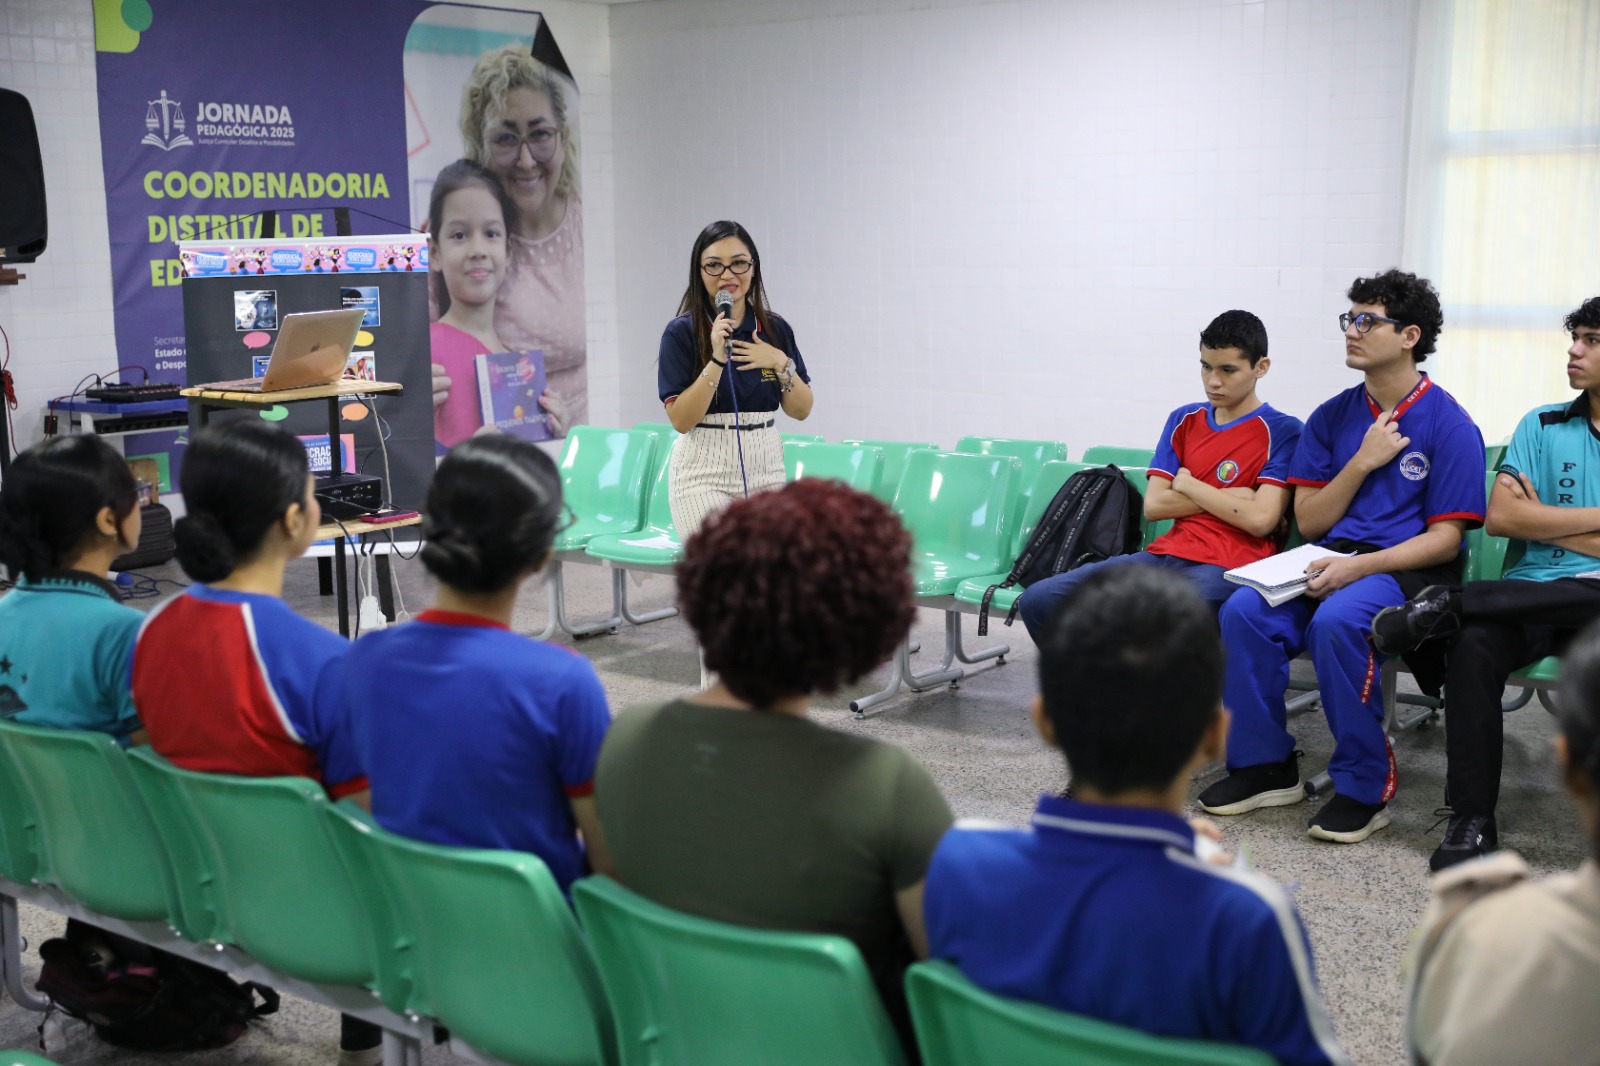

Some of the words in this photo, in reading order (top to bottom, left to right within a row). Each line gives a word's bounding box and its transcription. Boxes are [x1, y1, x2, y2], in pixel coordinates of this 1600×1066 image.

[196, 102, 293, 125] JORNADA
[196, 123, 269, 137] PEDAGÓGICA
[270, 127, 295, 138] 2025
[143, 170, 390, 200] COORDENADORIA
[292, 213, 324, 238] DE
[155, 348, 182, 358] Estado
[155, 362, 161, 370] e
[1053, 499, 1069, 521] KARGA
